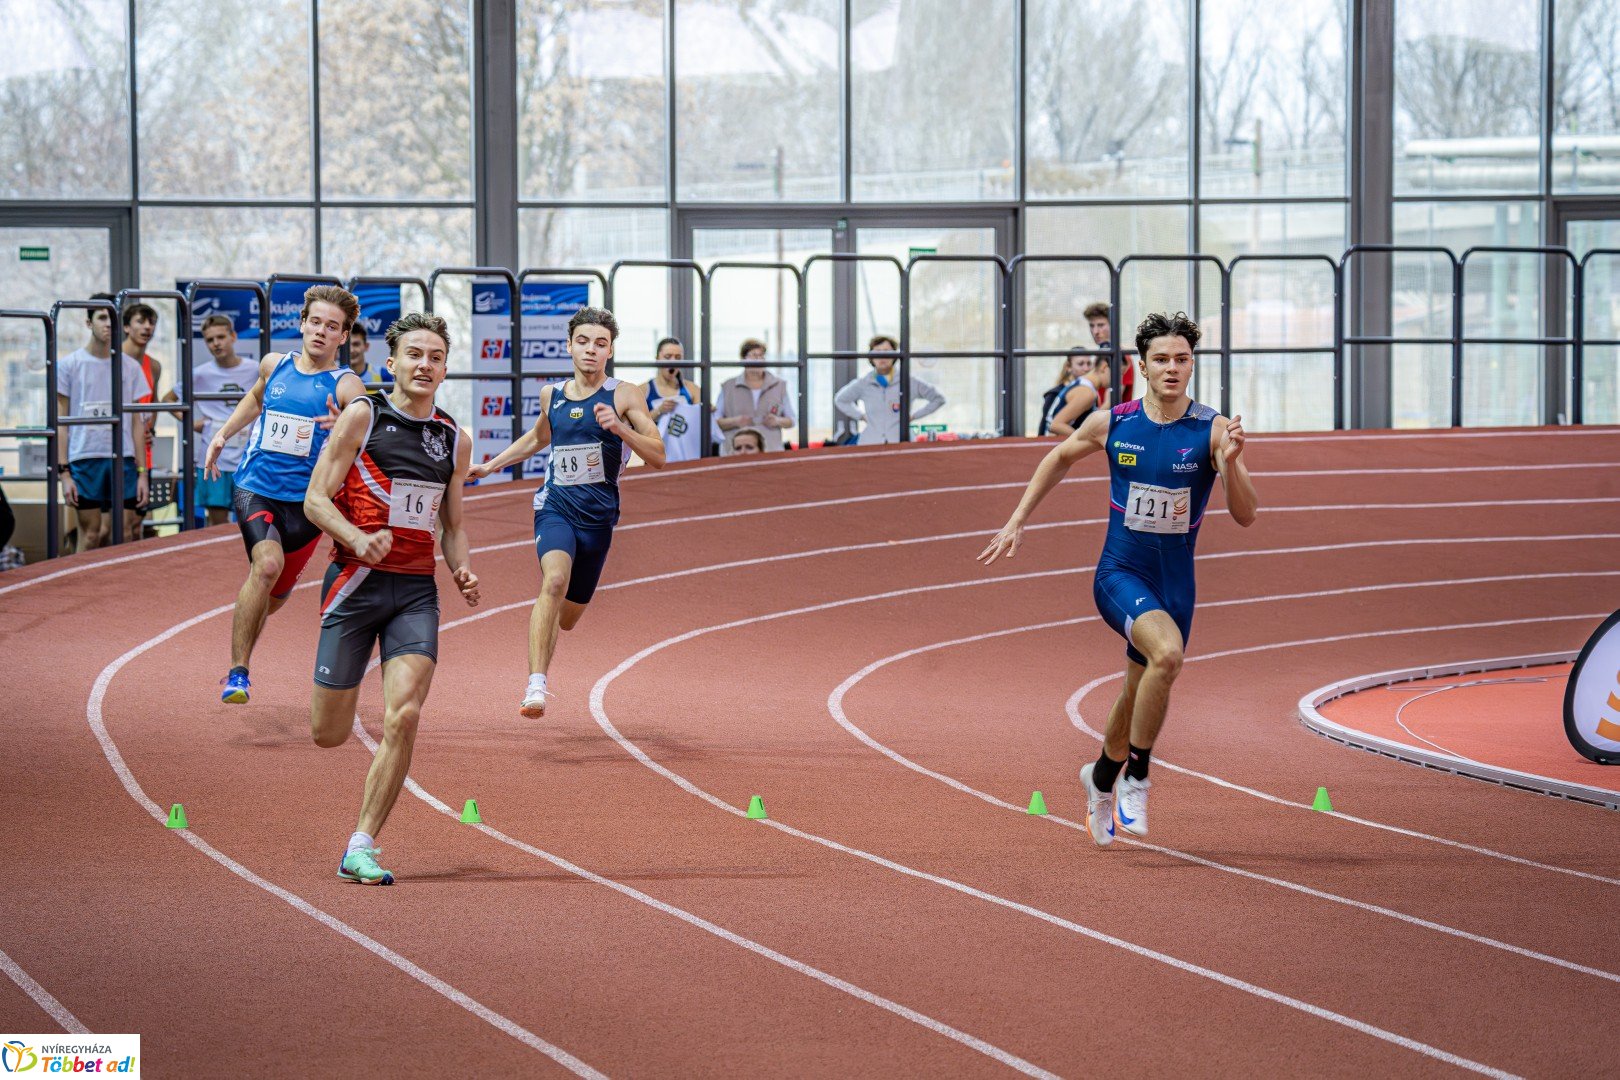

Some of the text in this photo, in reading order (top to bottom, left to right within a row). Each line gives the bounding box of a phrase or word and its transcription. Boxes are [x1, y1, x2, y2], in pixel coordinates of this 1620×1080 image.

[270, 421, 289, 440] 99
[561, 455, 579, 473] 48
[1120, 455, 1135, 464] SPP
[1172, 462, 1199, 470] NASA
[404, 493, 424, 514] 16
[1134, 496, 1168, 519] 121
